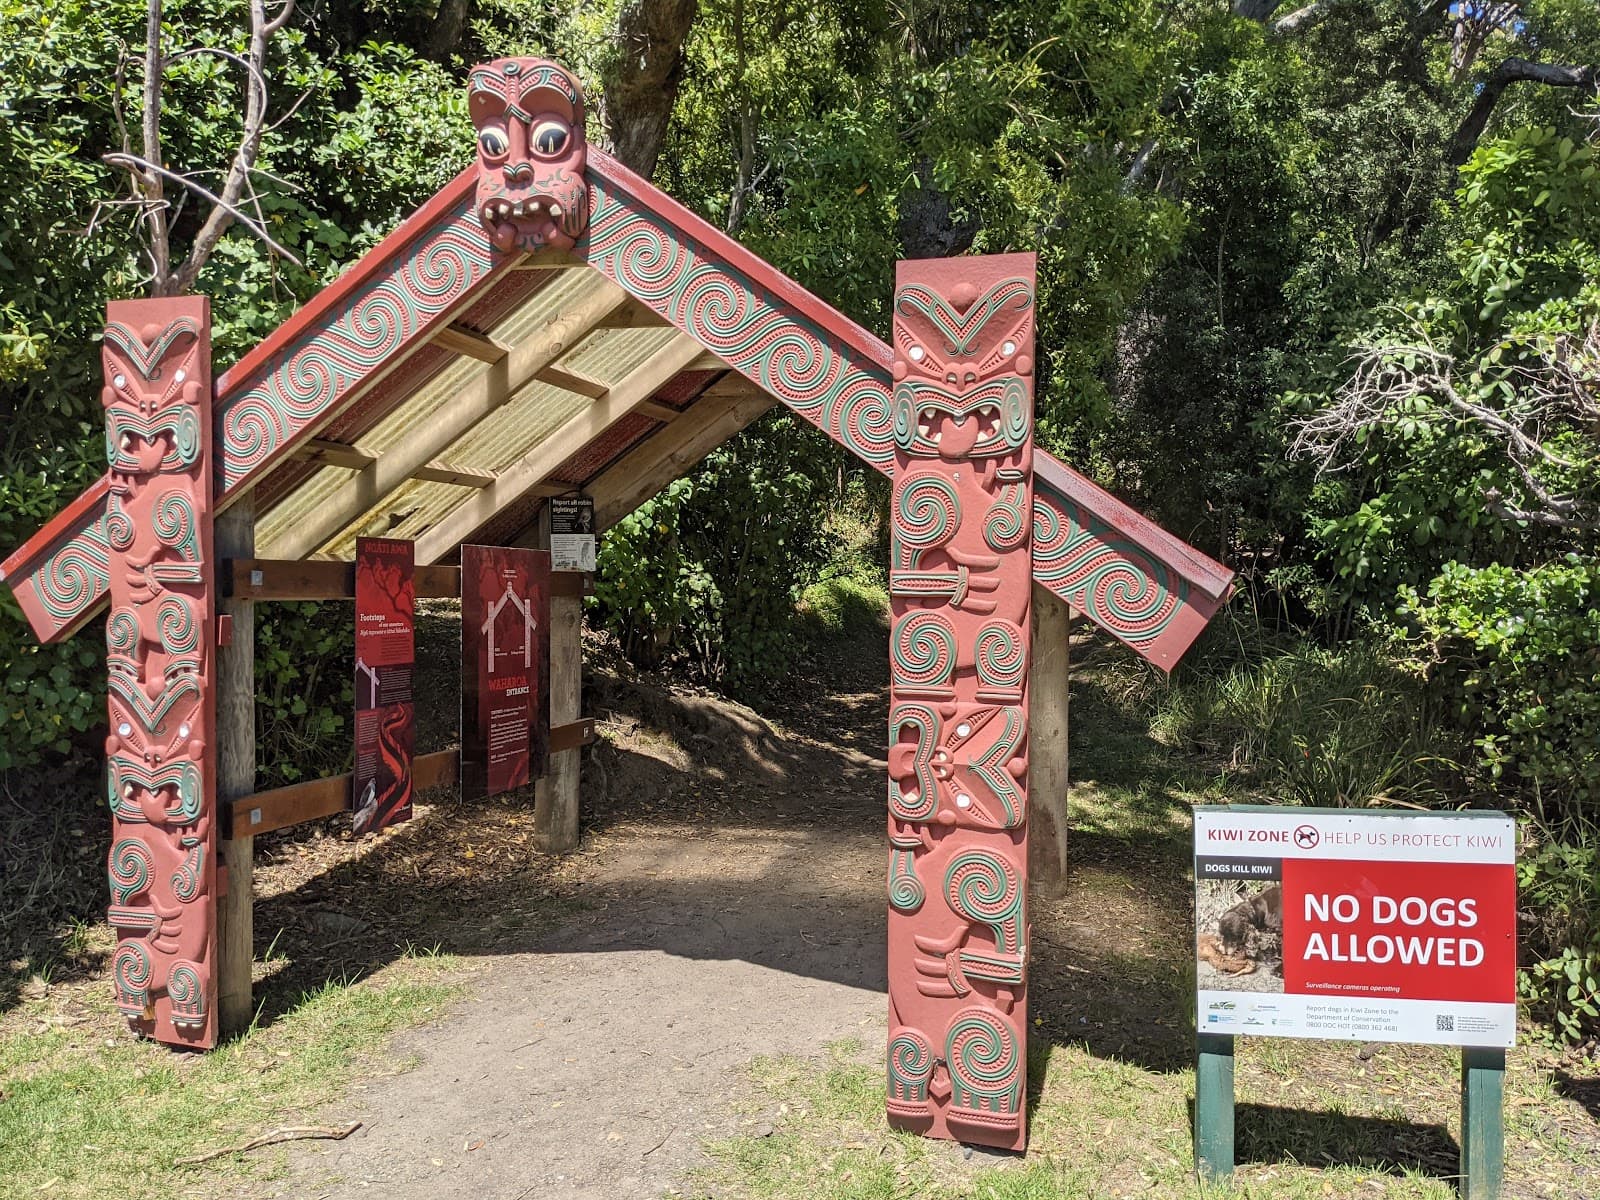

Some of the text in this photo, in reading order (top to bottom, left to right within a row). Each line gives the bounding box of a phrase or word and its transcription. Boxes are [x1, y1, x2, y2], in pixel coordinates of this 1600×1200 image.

[360, 613, 385, 622] Footsteps
[489, 676, 528, 690] WAHAROA
[506, 686, 529, 696] ENTRANCE
[1207, 829, 1289, 842] KIWI ZONE
[1324, 831, 1502, 849] HELP US PROTECT KIWI
[1205, 864, 1273, 874] DOGS KILL KIWI
[1304, 893, 1478, 928] NO DOGS
[1303, 932, 1485, 967] ALLOWED
[1306, 982, 1342, 990] Surveillance
[1306, 1005, 1326, 1013] Report
[1306, 1013, 1342, 1021] Department
[1352, 1015, 1391, 1023] Conservation
